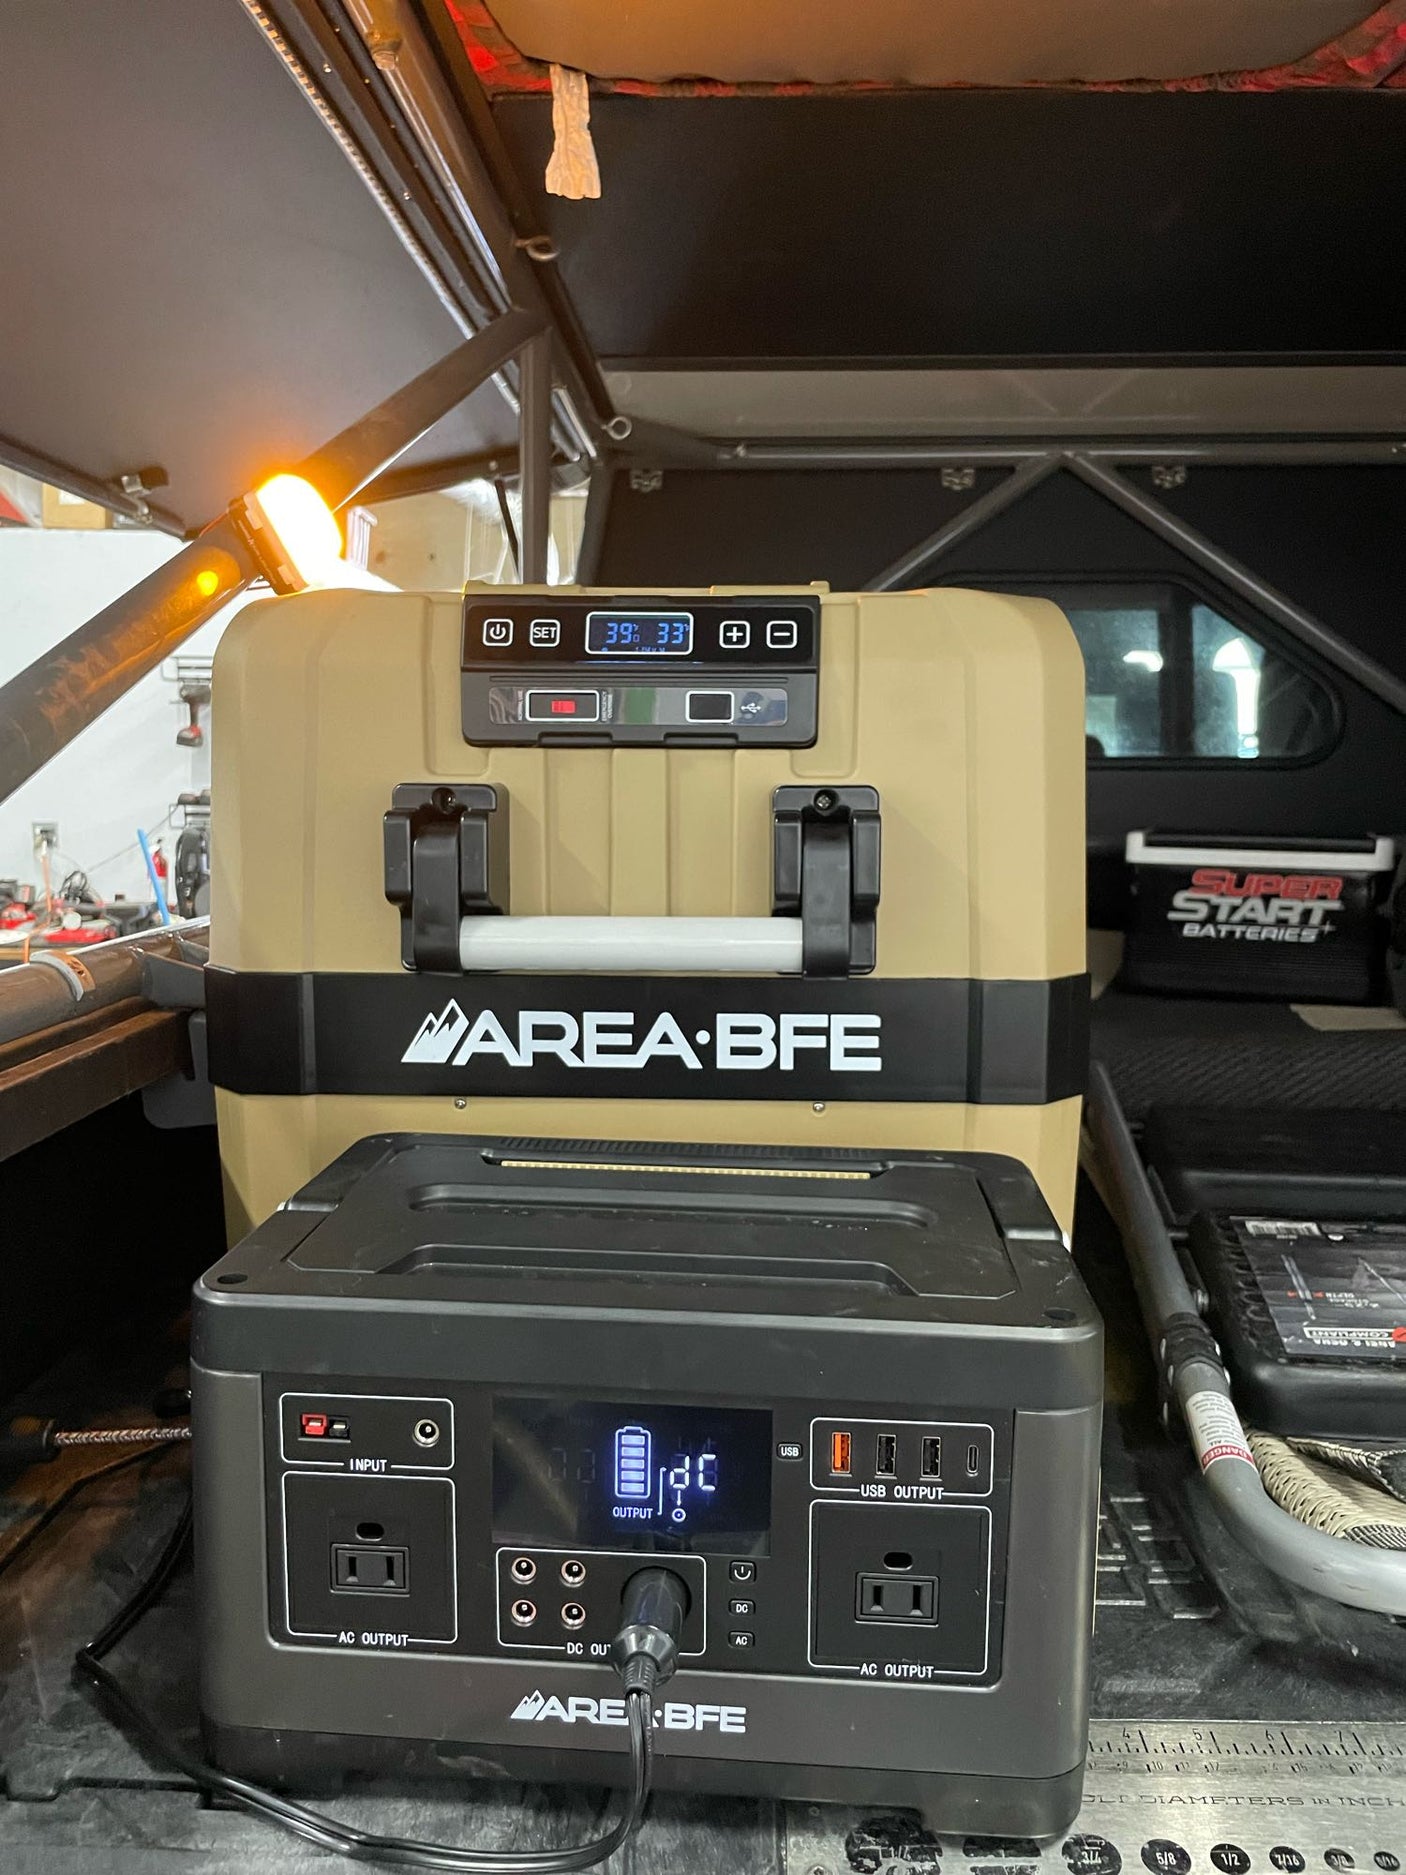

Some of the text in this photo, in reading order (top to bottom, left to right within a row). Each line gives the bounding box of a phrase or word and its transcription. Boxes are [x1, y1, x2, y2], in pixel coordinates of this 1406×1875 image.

[532, 627, 557, 639] SET
[1188, 868, 1343, 900] SUPER
[1167, 890, 1343, 926] START
[1182, 922, 1320, 944] BATTERIES
[780, 1446, 799, 1457] USB
[349, 1459, 387, 1472] INPUT
[860, 1485, 944, 1500] USB OUTPUT
[612, 1506, 654, 1519] OUTPUT
[735, 1603, 748, 1613] DC
[338, 1631, 409, 1647] AC OUTPUT
[735, 1636, 748, 1645] AC
[566, 1642, 583, 1655] DC
[860, 1664, 934, 1679] AC OUTPUT
[1122, 1727, 1131, 1739] 4
[1192, 1728, 1202, 1741] 5
[1156, 1851, 1177, 1866] 5/8
[1221, 1852, 1241, 1866] 1/2
